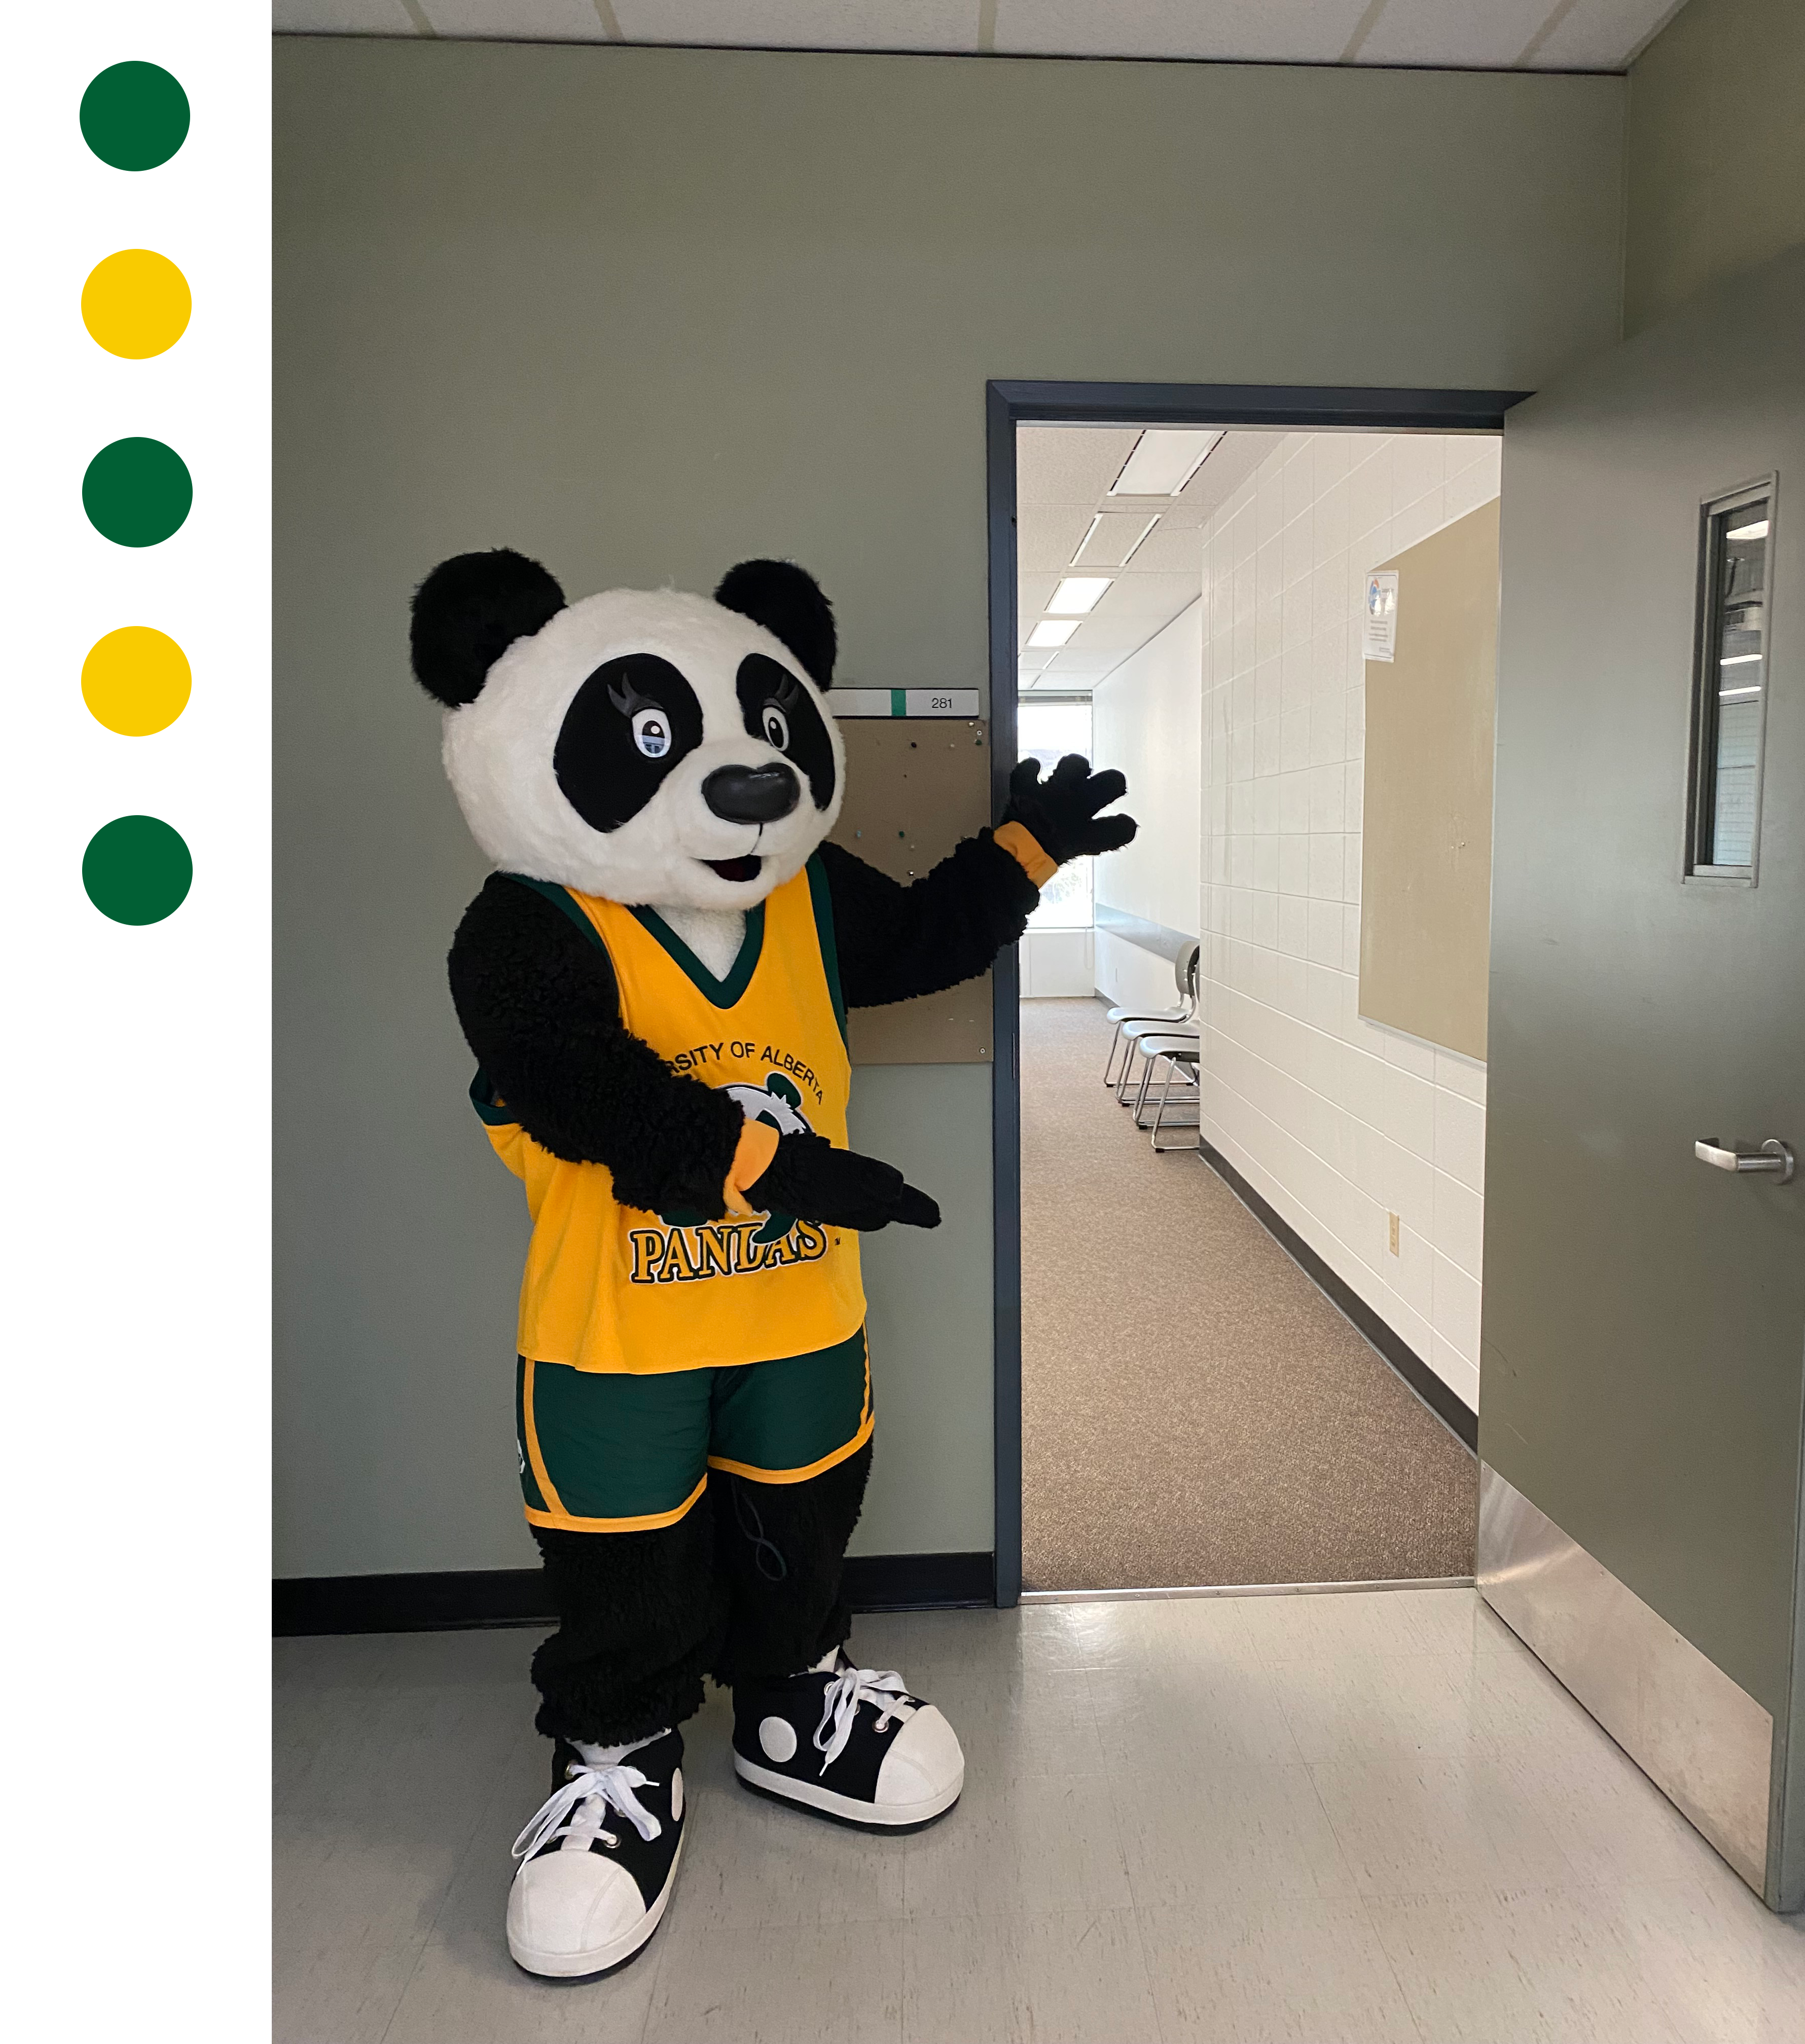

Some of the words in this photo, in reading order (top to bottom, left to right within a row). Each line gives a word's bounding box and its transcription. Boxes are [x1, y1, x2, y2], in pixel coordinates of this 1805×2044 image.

[931, 698, 952, 709] 281
[665, 1042, 724, 1073] RSITY
[730, 1041, 755, 1058] OF
[760, 1045, 823, 1106] ALBERTA
